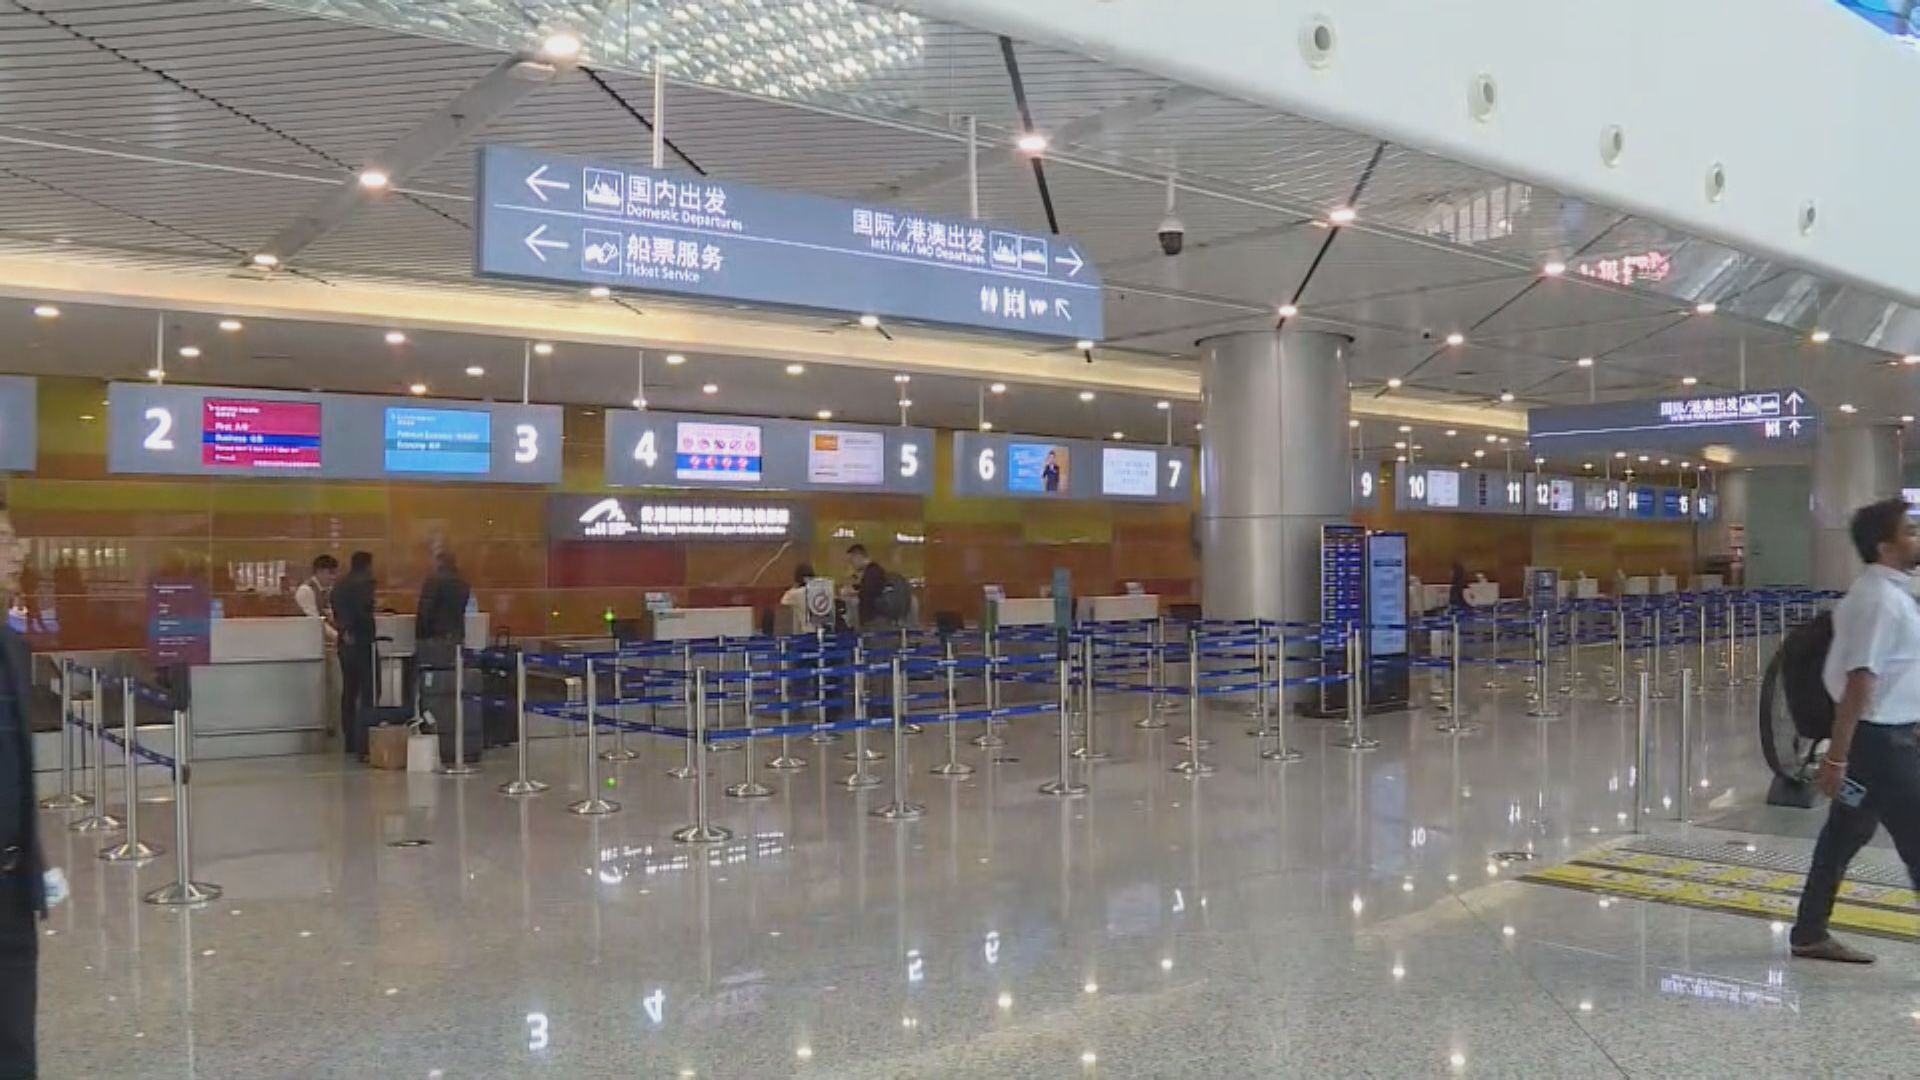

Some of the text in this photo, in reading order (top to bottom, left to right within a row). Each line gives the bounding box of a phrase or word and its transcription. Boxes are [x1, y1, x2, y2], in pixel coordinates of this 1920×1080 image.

[628, 174, 727, 216] 国内出发
[626, 202, 743, 232] Domestic Departures
[852, 207, 986, 254] 国际/港澳出发
[626, 232, 724, 272] 船票服务
[625, 261, 700, 283] Ticket Service
[143, 407, 174, 450] 2
[514, 424, 539, 463] 3
[633, 430, 658, 467] 4
[900, 444, 918, 477] 5
[978, 448, 995, 480] 6
[1168, 460, 1182, 488] 7
[1361, 471, 1373, 497] 9
[1408, 475, 1425, 499] 10
[1507, 482, 1521, 504] 11
[1536, 484, 1549, 505] 12
[1607, 489, 1619, 509] 13
